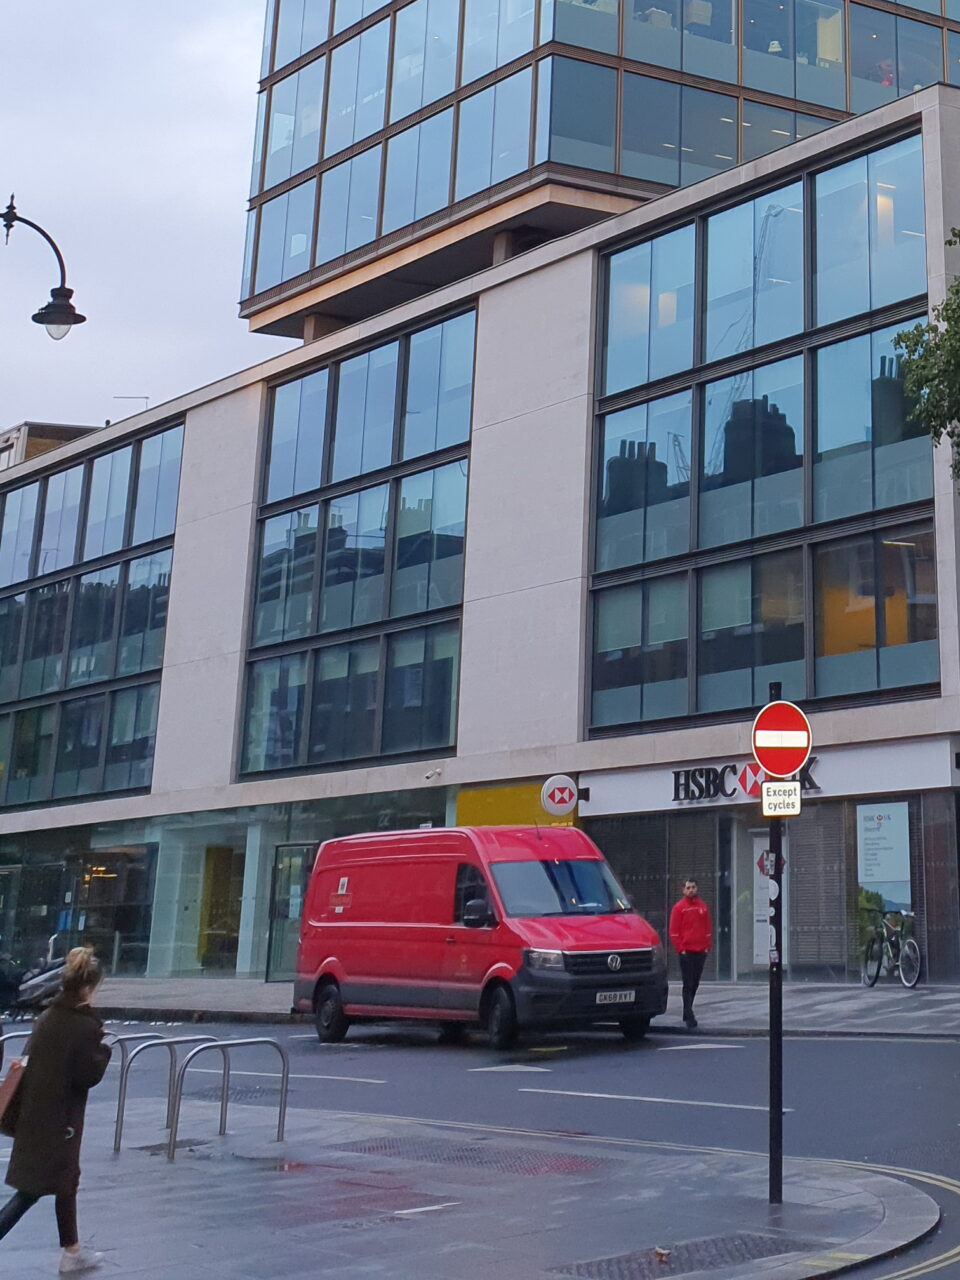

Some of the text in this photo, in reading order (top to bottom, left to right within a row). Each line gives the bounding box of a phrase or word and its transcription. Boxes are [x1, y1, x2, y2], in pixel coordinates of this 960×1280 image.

[672, 764, 737, 801] HSBC
[766, 786, 797, 799] Except
[767, 800, 796, 812] cycles
